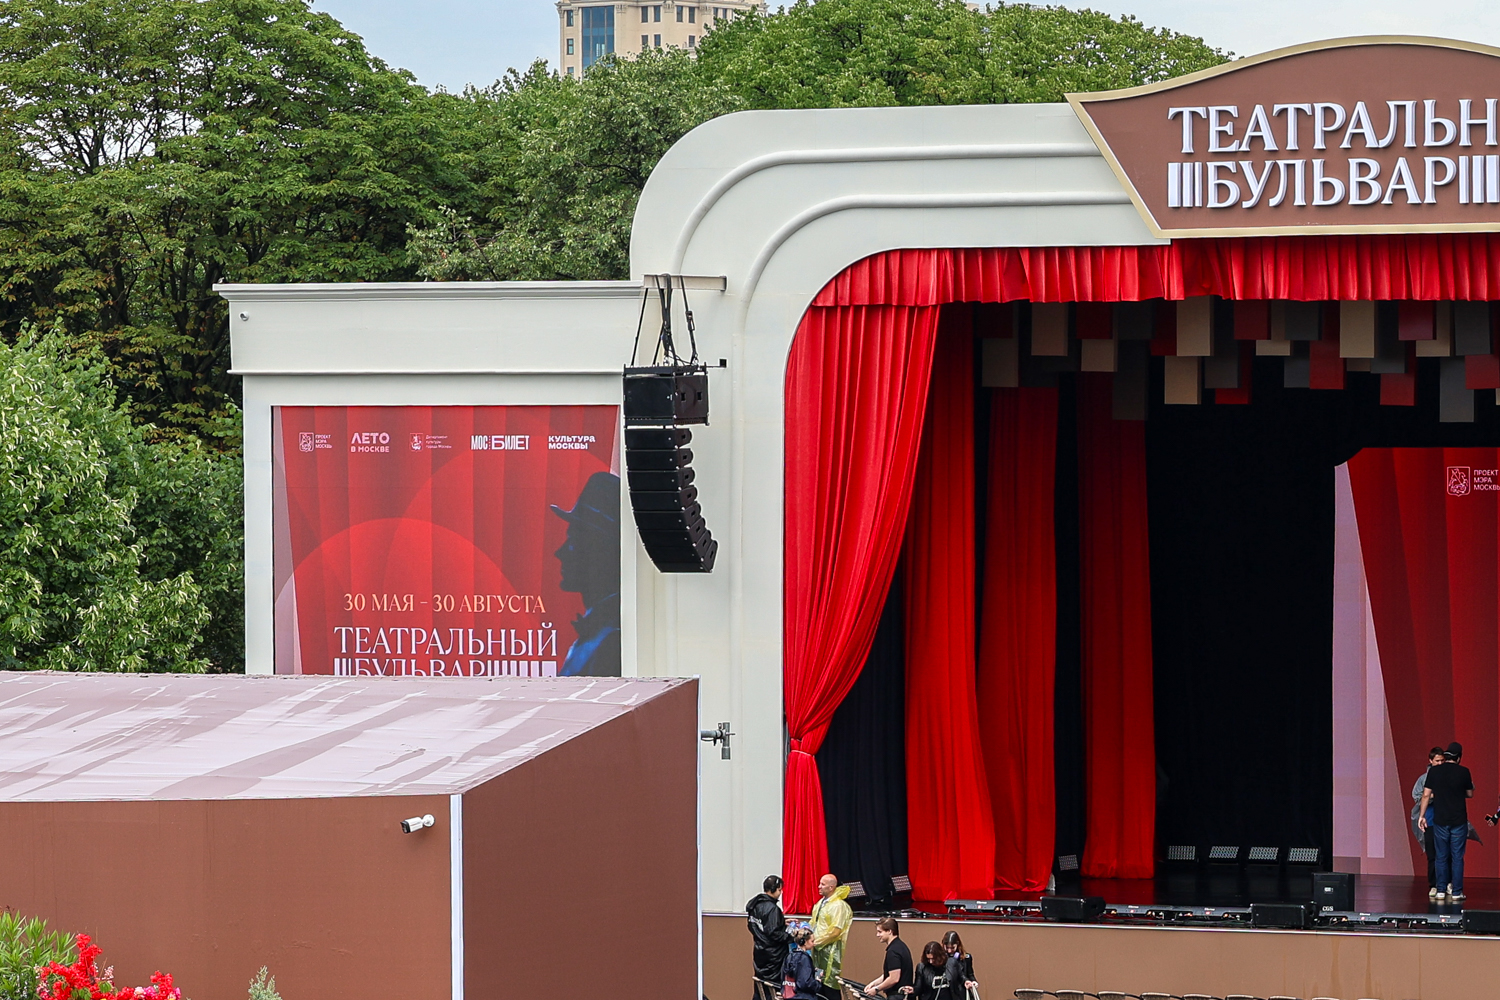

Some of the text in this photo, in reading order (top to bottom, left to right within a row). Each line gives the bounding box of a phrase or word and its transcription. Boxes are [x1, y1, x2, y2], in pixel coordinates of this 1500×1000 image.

[1206, 154, 1457, 209] БУЛЬВАР
[350, 432, 390, 444] ЛЕТО
[471, 435, 530, 450] МОС БИЛЕТ
[344, 593, 366, 612] 30
[372, 593, 415, 612] МАЯ
[433, 593, 455, 612] 30
[459, 594, 546, 614] АВГУСТА
[334, 622, 557, 656] ТЕАТРАЛЬНЫЙ
